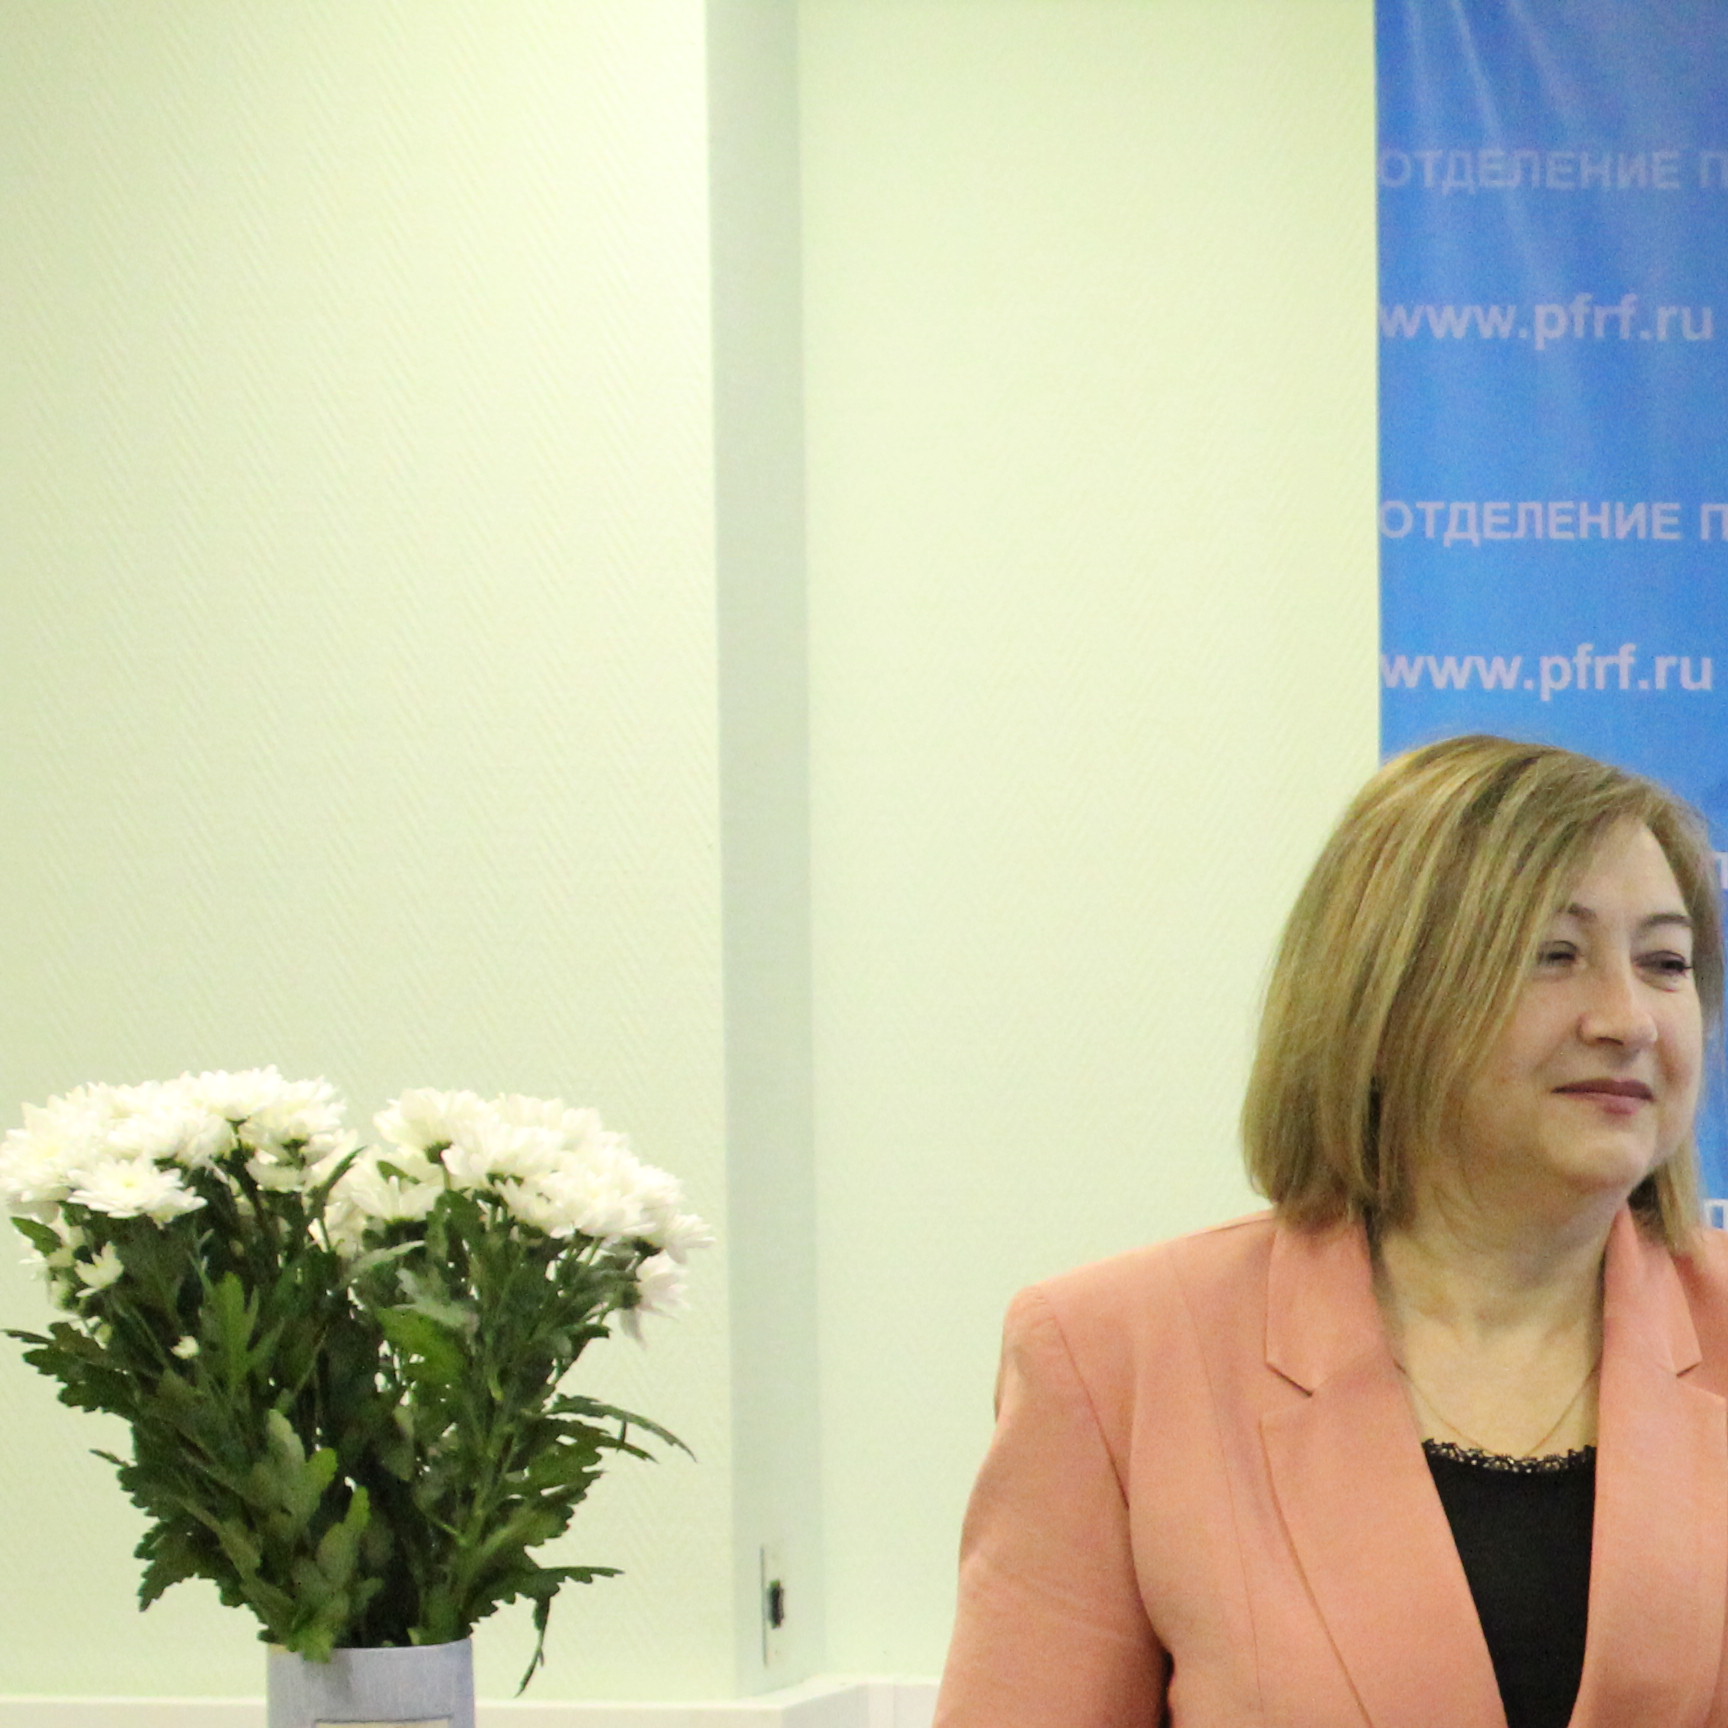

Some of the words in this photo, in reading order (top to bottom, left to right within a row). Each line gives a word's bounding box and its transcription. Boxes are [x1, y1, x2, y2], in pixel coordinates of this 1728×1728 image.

[1380, 149, 1680, 195] ОТДЕЛЕНИЕ
[1380, 294, 1713, 348] www.pfrf.ru
[1380, 501, 1680, 546] ОТДЕЛЕНИЕ
[1380, 643, 1713, 699] www.pfrf.ru
